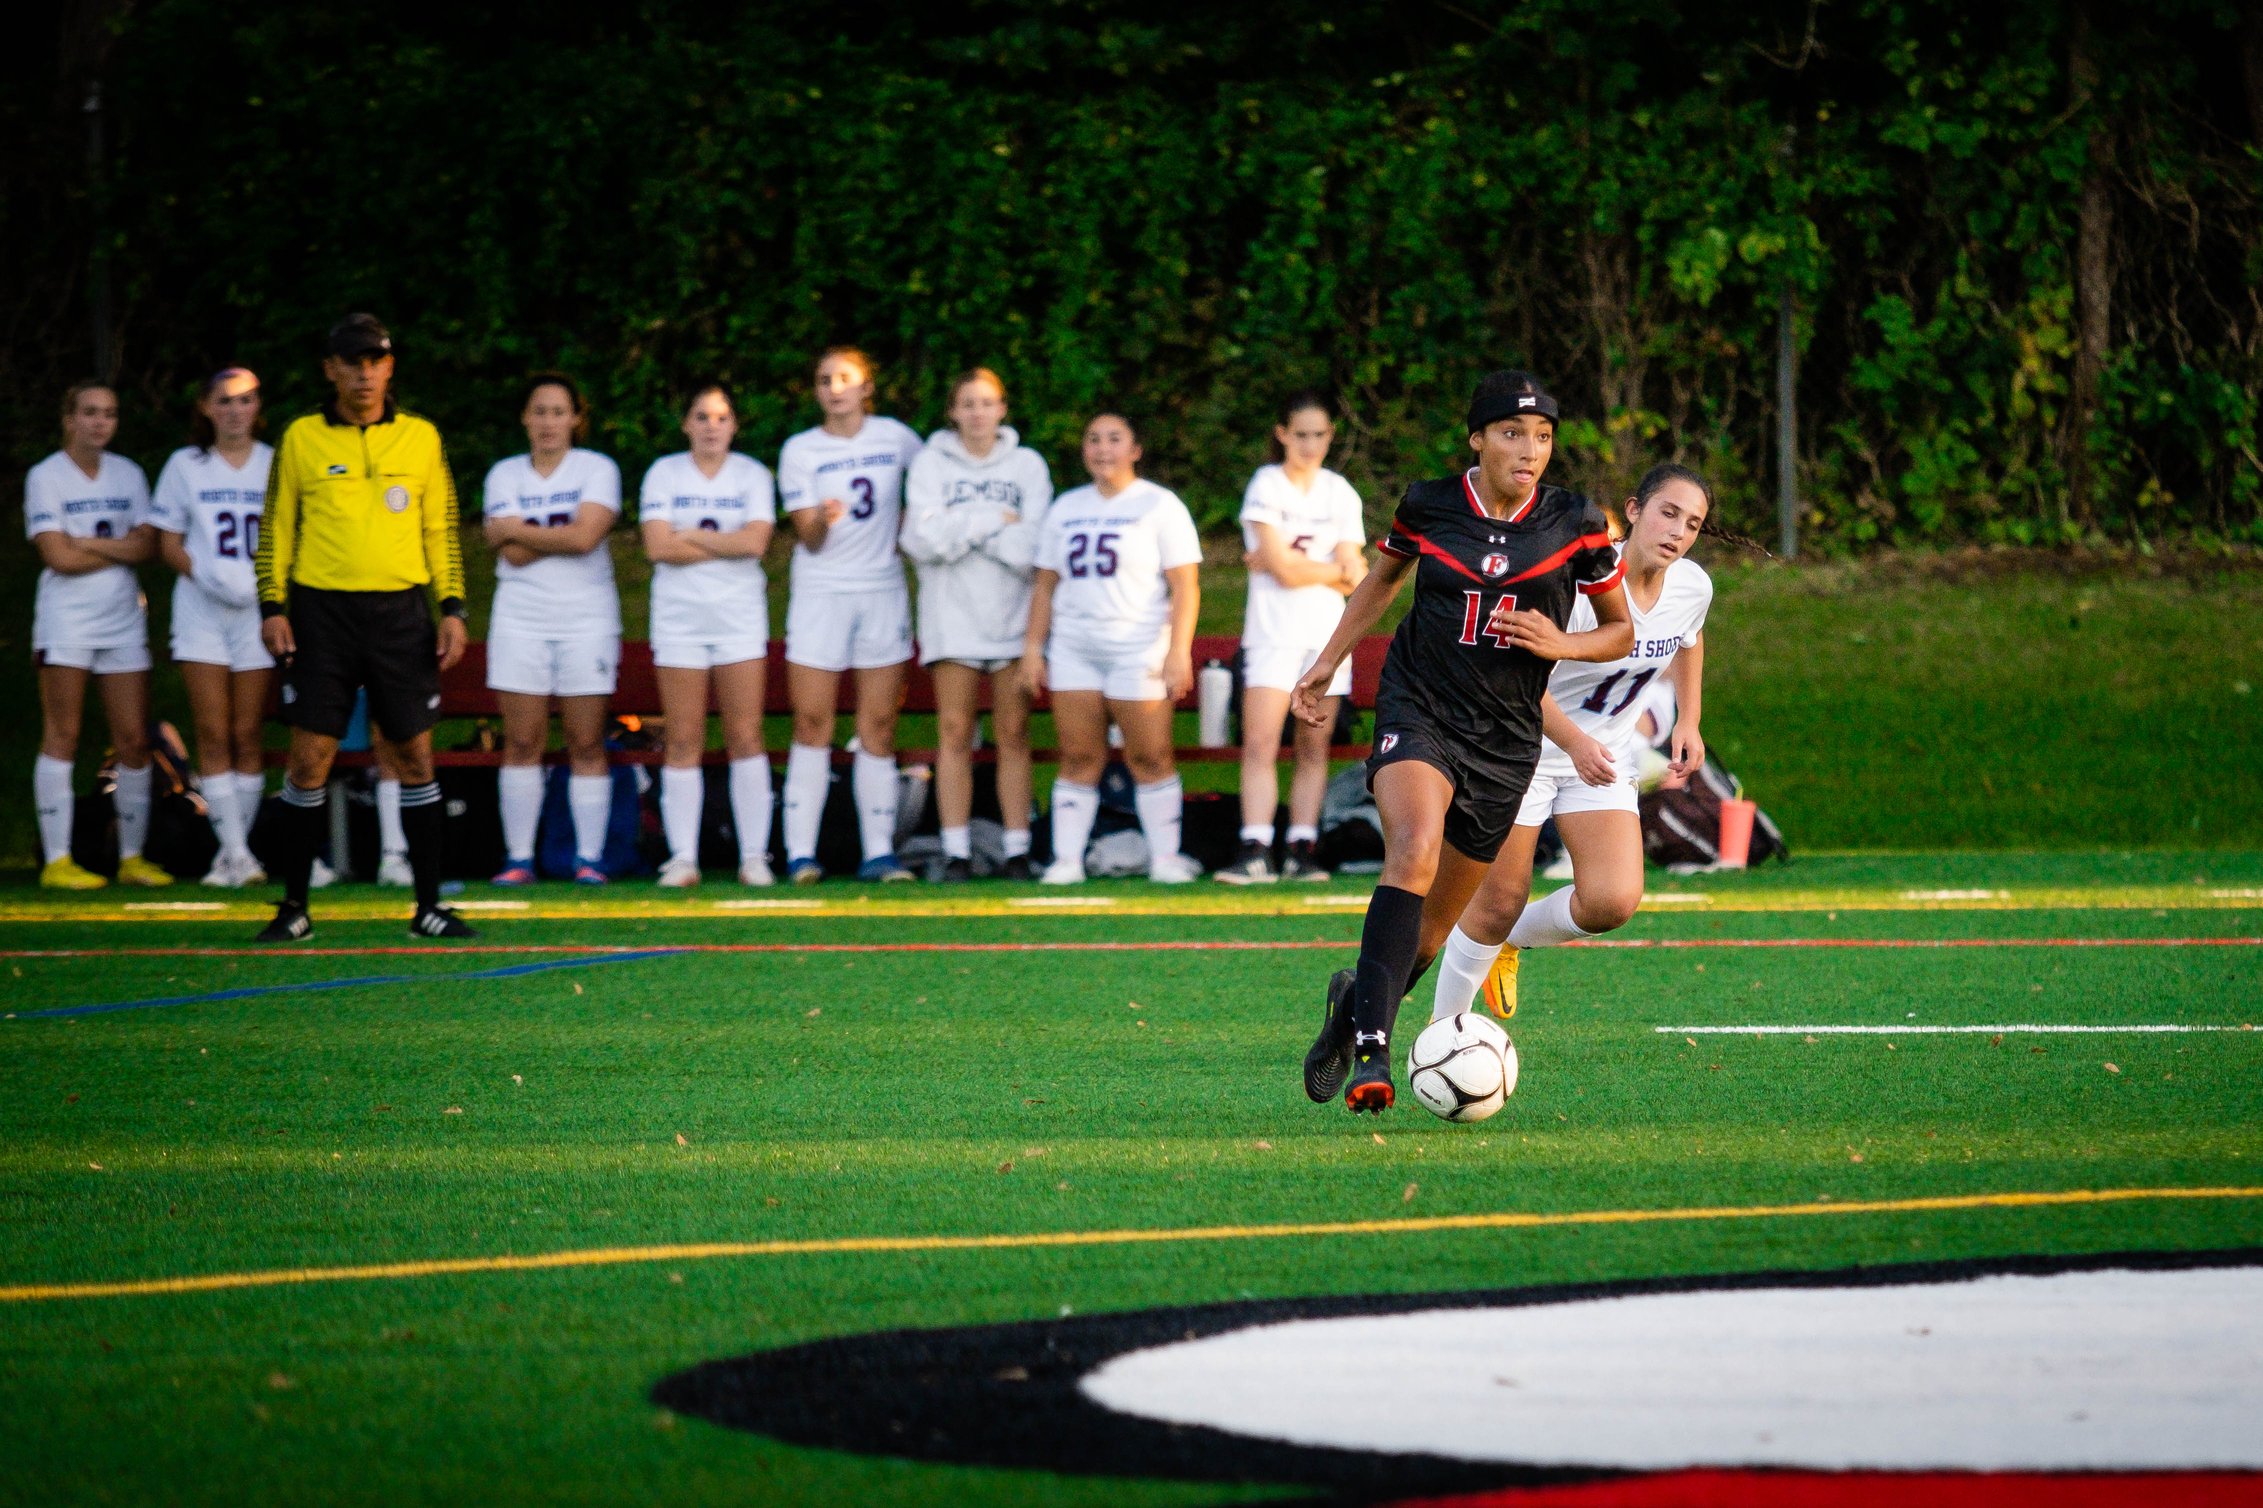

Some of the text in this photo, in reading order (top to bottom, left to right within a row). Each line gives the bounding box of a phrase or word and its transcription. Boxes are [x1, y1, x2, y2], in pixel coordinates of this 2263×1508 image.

[851, 477, 873, 520] 3
[1068, 533, 1120, 577] 25
[1483, 554, 1508, 577] F
[1458, 590, 1517, 649] 14
[1645, 635, 1685, 658] SHOR
[1580, 667, 1658, 717] 11
